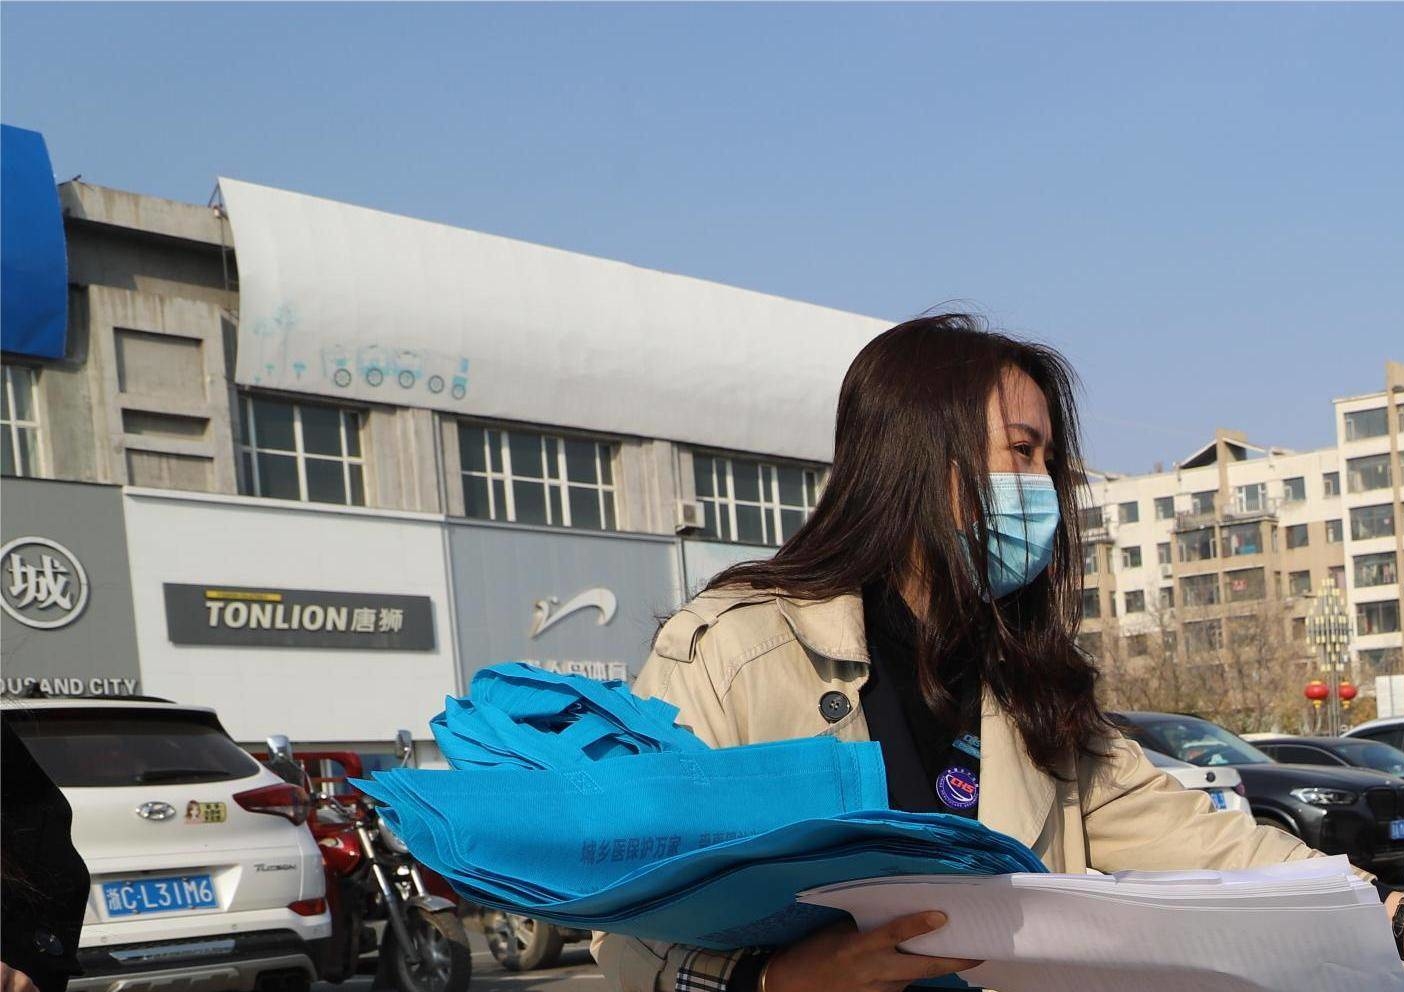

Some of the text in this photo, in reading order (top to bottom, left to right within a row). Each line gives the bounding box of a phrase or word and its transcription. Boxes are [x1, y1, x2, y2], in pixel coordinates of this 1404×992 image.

[8, 553, 73, 611] 城
[206, 600, 403, 633] TONLION 唐狮
[90, 677, 138, 695] CITY
